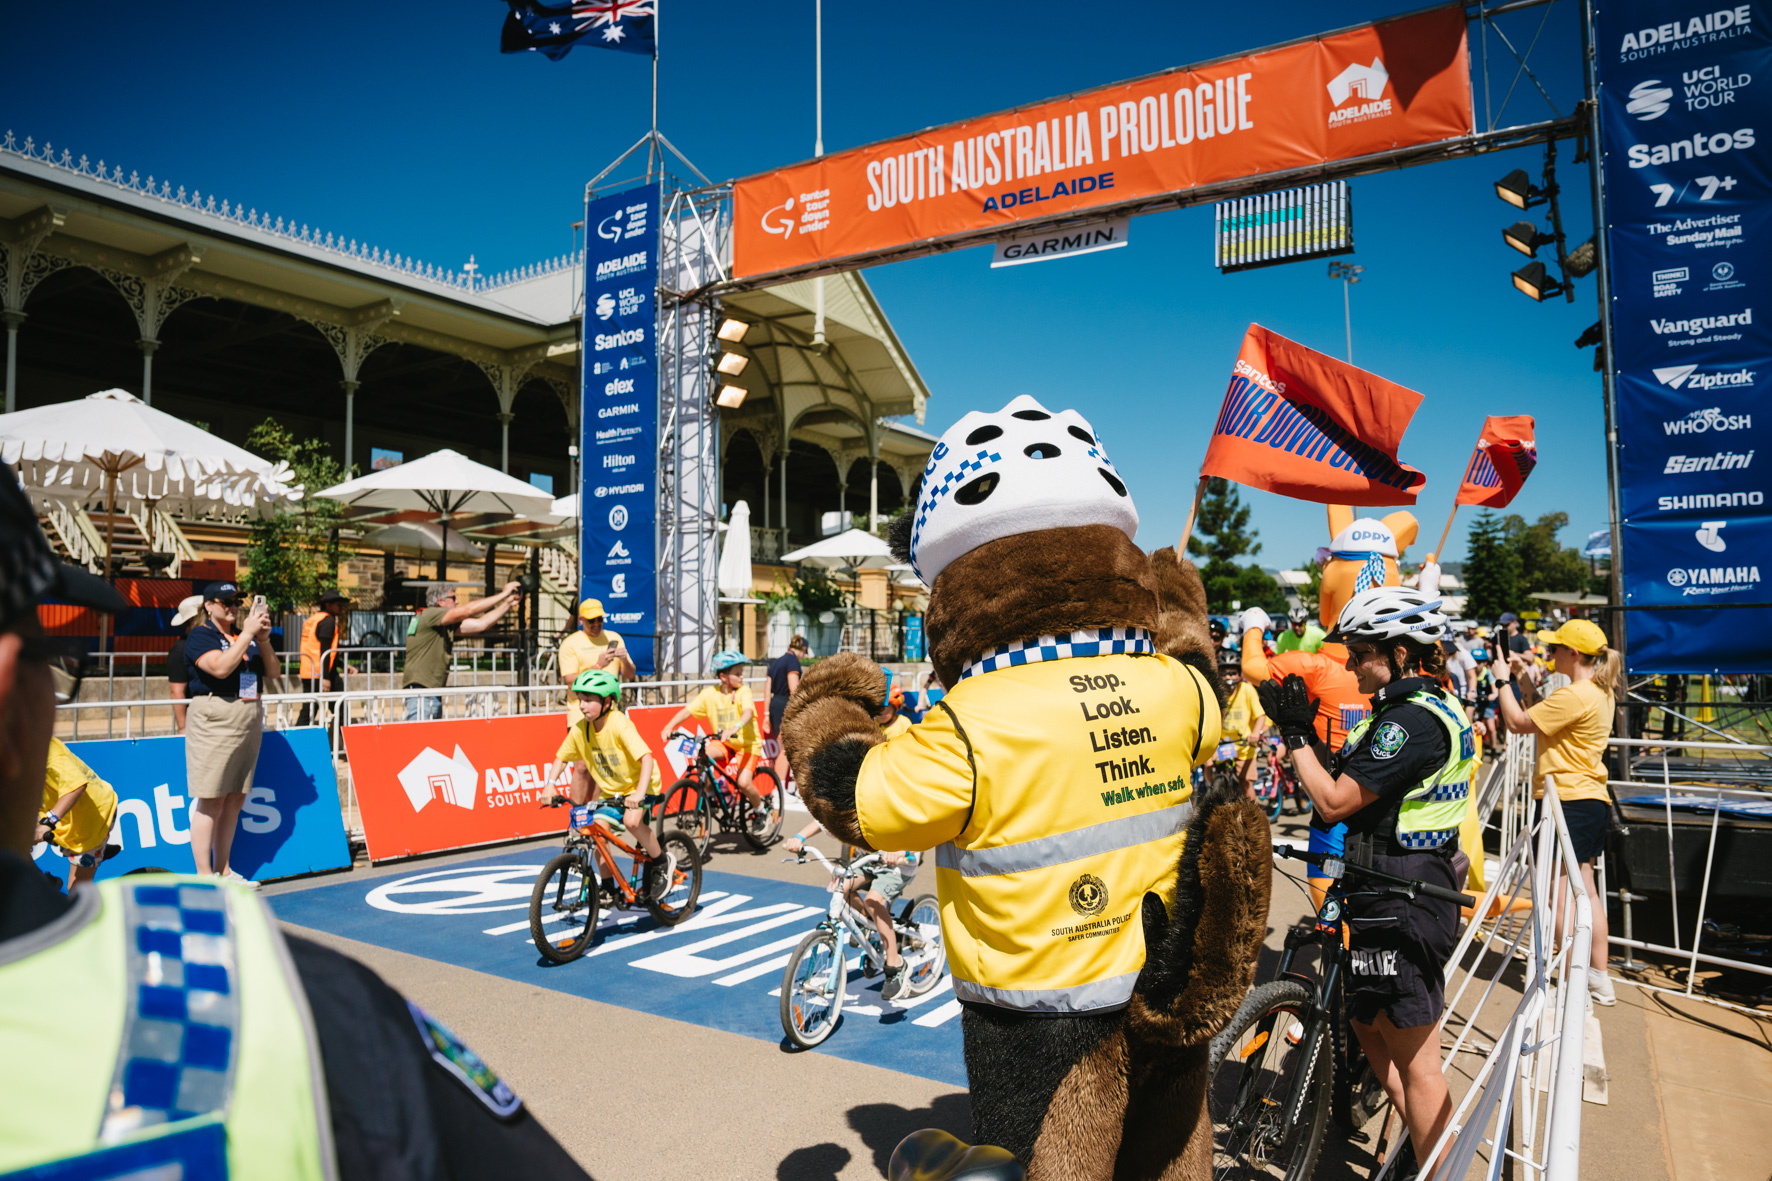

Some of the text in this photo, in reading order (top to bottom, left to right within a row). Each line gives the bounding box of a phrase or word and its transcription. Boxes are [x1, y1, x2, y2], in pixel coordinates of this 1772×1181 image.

[1620, 4, 1751, 53] ADELAIDE
[1620, 25, 1752, 63] SOUTH AUSTRALIA
[1682, 65, 1720, 84] UCI
[1684, 73, 1752, 98] WORLD
[1685, 91, 1736, 111] TOUR
[1328, 98, 1392, 124] ADELAIDE
[1328, 110, 1392, 129] SOUTH AUSTRALIA
[866, 72, 1254, 212] SOUTH AUSTRALIA PROLOGUE
[1628, 128, 1756, 169] Santos
[800, 189, 830, 203] Santos
[982, 172, 1115, 213] ADELAIDE
[626, 203, 647, 214] Santos
[806, 199, 830, 212] tour
[626, 219, 647, 230] down
[630, 211, 648, 222] tour
[801, 209, 830, 223] down
[1646, 214, 1741, 235] The Advertiser
[624, 227, 647, 239] under
[799, 220, 830, 234] under
[1666, 225, 1742, 246] Sunday Mail
[1003, 227, 1114, 259] GARMIN
[595, 264, 647, 282] SOUTH AUSTRALIA
[596, 251, 647, 276] ADELAIDE
[1657, 271, 1685, 281] THINK!
[619, 288, 635, 299] UCI
[1653, 283, 1677, 291] ROAD
[1654, 288, 1682, 298] SAFETY
[619, 294, 646, 307] WORLD
[619, 304, 638, 316] TOUR
[1650, 308, 1752, 335] Vanguard
[595, 328, 644, 351] Santos
[1667, 333, 1742, 347] Strong and Steady
[605, 378, 634, 396] efex
[1687, 368, 1753, 390] Ziptrak
[598, 403, 639, 419] GARMIN
[1663, 414, 1752, 436] WHOOSH
[603, 454, 636, 468] Hilton
[1663, 450, 1755, 475] Santini
[609, 484, 644, 495] HYUNDAI
[1658, 491, 1764, 511] SHIMANO
[1352, 530, 1391, 543] OPPY
[1687, 566, 1761, 585] YAMAHA
[1409, 622, 1432, 631] Police
[1069, 673, 1126, 693] Stop.
[1080, 696, 1140, 722] Look.
[1089, 726, 1157, 753] Listen.
[1095, 754, 1156, 784] Think.
[487, 791, 531, 808] SOUTH
[1101, 786, 1135, 807] Walk
[1135, 782, 1167, 799] when
[1051, 912, 1132, 936] SOUTH AUSTRALIA POLICE
[1068, 926, 1120, 942] SAFER COMMUNITIES
[1350, 950, 1398, 976] POLICE
